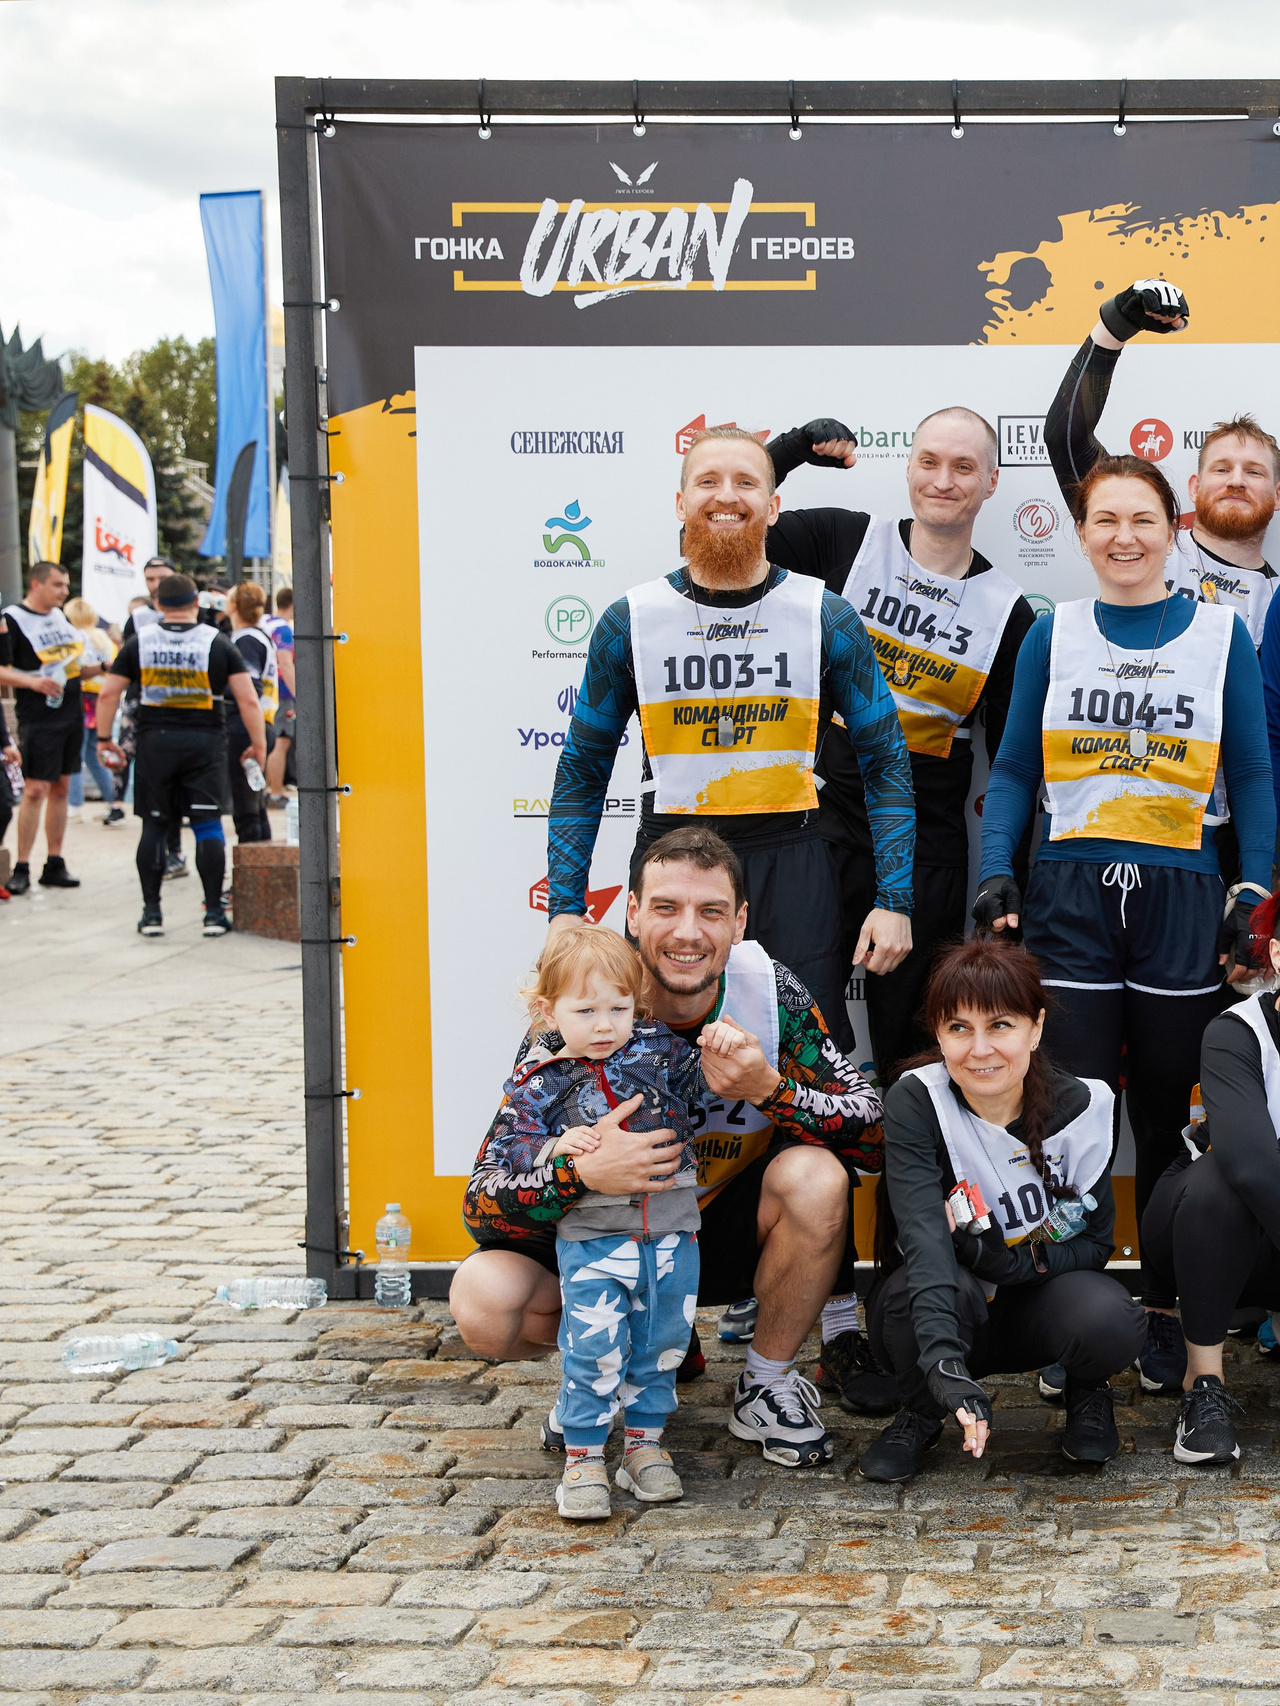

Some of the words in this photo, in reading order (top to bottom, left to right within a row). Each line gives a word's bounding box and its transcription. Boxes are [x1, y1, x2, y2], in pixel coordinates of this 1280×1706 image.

[414, 237, 504, 261] ГОНКА
[519, 178, 754, 300] URBAN
[751, 237, 855, 260] ГЕРОЕВ
[510, 431, 625, 454] СЕНЕЖСКАЯ
[1007, 445, 1047, 455] KITCH
[908, 579, 948, 602] URBAN
[706, 620, 749, 641] URBAN
[859, 587, 973, 656] 1004-3
[532, 650, 588, 659] Performance
[663, 652, 792, 693] 1003-1
[1116, 662, 1158, 679] URBAN
[1067, 687, 1195, 730] 1004-5
[1071, 737, 1188, 763] КОМАННЫЙ
[1008, 1155, 1027, 1164] ГОНКА
